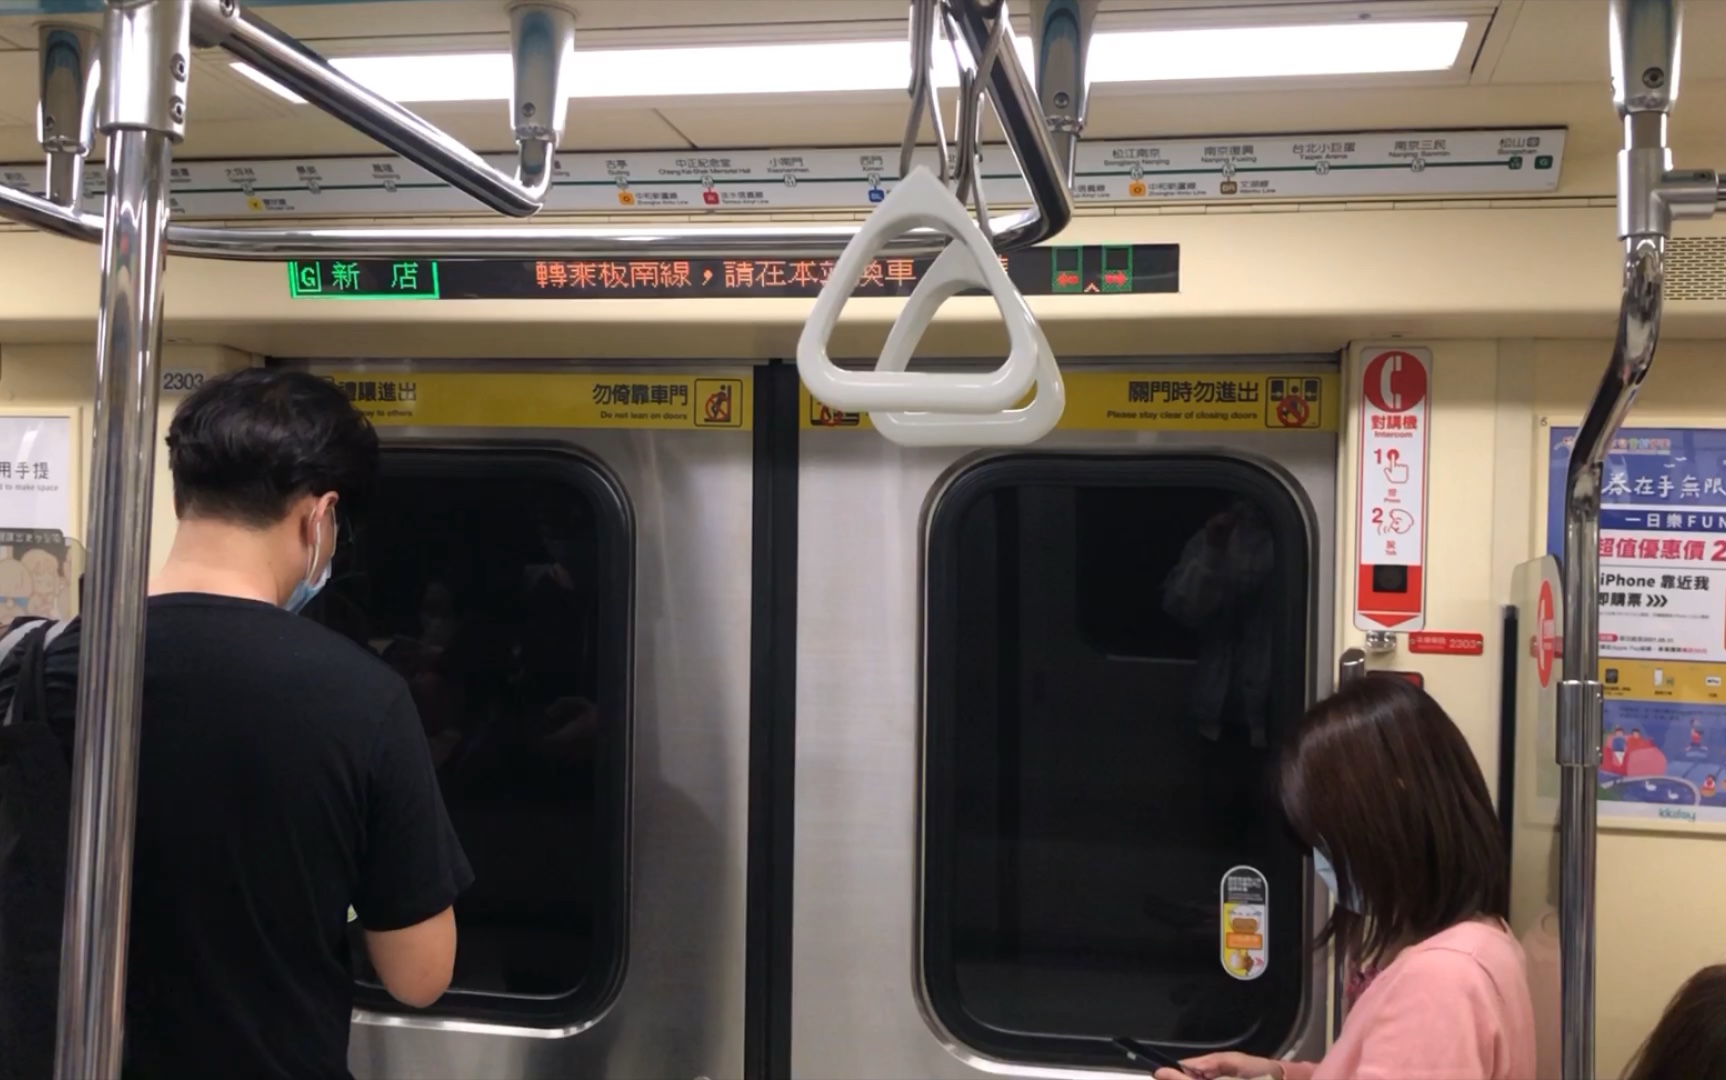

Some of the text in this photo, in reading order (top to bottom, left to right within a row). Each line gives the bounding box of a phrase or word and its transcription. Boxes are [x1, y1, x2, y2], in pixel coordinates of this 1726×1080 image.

[1204, 145, 1254, 156] 南京復興
[1293, 142, 1356, 153] 台北小巨蛋
[1394, 140, 1447, 150] 南京三民
[1499, 138, 1525, 148] 松山
[1112, 148, 1161, 159] 松江南京
[675, 158, 731, 168] 中正紀念堂
[300, 267, 316, 287] G
[331, 261, 419, 290] 新店
[163, 373, 204, 389] 2303
[592, 383, 688, 406] 勿倚靠車門
[1128, 381, 1259, 403] 關門時勿進出
[1107, 410, 1137, 418] Please
[1139, 411, 1157, 419] stay
[1196, 411, 1228, 420] closing
[1371, 415, 1417, 430] 對講機
[1374, 430, 1413, 438] Intercom
[1374, 448, 1382, 465] 1
[1372, 507, 1384, 524] 2
[1599, 538, 1705, 560] 超值優惠價
[1600, 572, 1710, 591] iPhone 靠近我
[1599, 592, 1642, 608] 即購票
